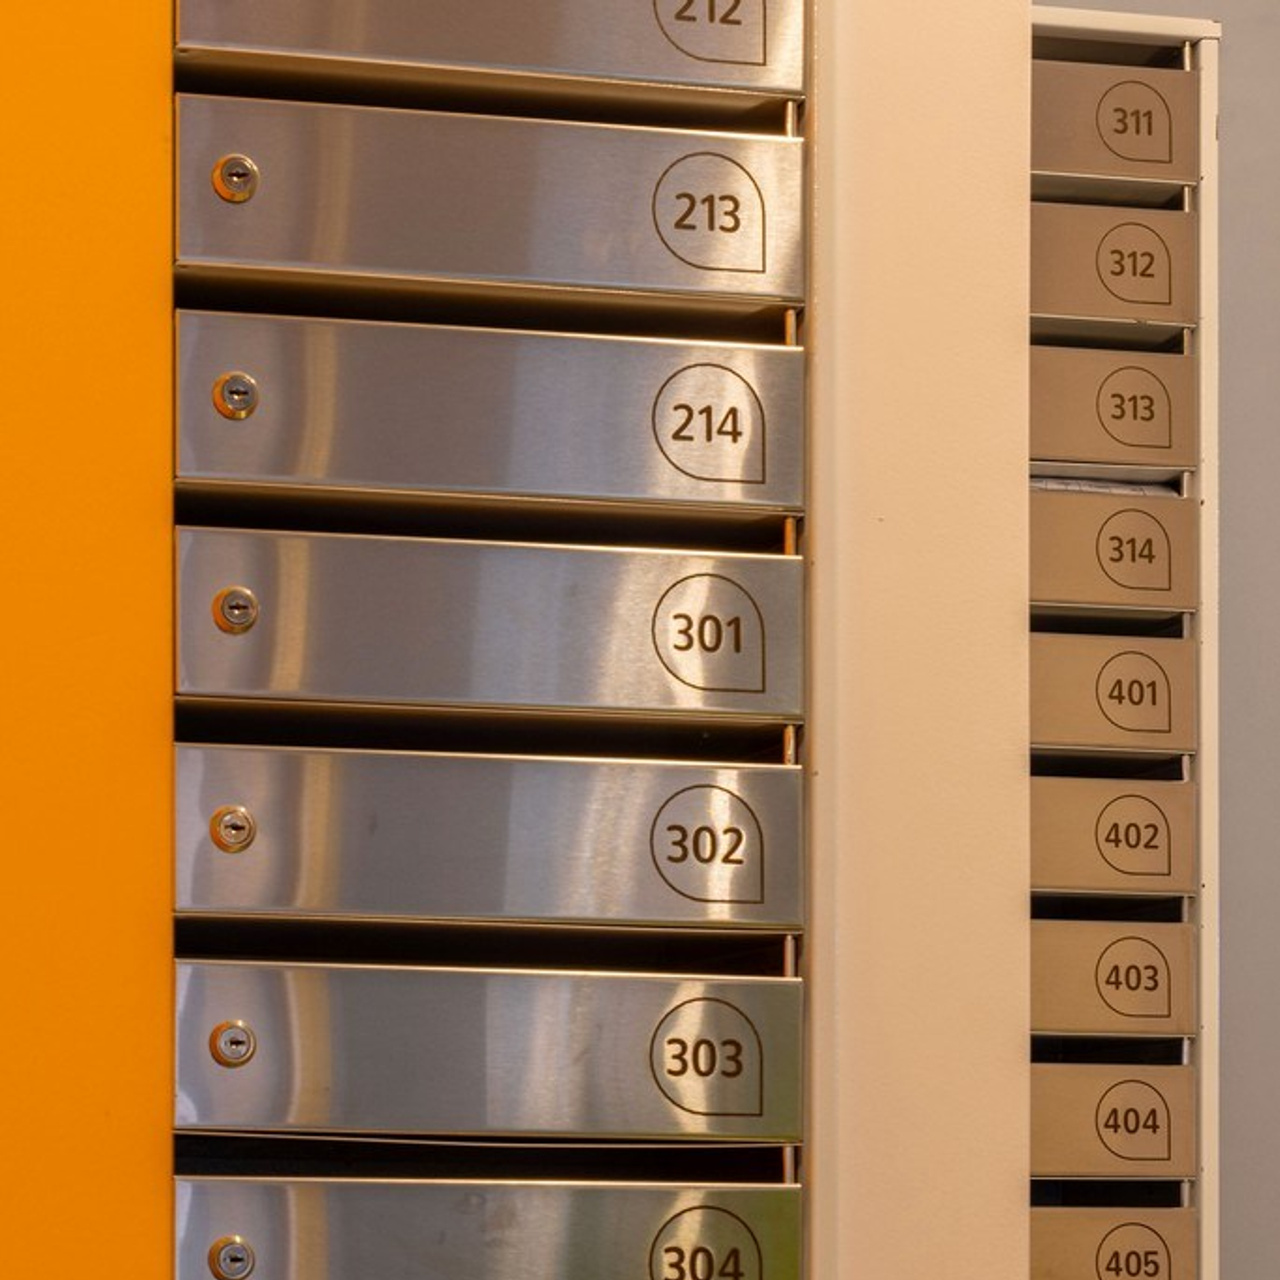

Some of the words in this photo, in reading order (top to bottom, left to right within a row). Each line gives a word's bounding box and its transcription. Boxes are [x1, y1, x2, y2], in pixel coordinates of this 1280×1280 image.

[1114, 108, 1152, 136] 311
[675, 193, 740, 233] 213
[1111, 250, 1154, 278] 312
[1111, 394, 1154, 421] 313
[672, 404, 742, 443] 214
[1109, 536, 1155, 563] 314
[673, 614, 740, 652] 301
[1108, 679, 1156, 705] 401
[667, 825, 743, 864] 302
[1105, 823, 1158, 849] 402
[1105, 965, 1158, 991] 403
[667, 1038, 741, 1077] 303
[1104, 1108, 1160, 1134] 404
[1105, 1251, 1159, 1277] 405
